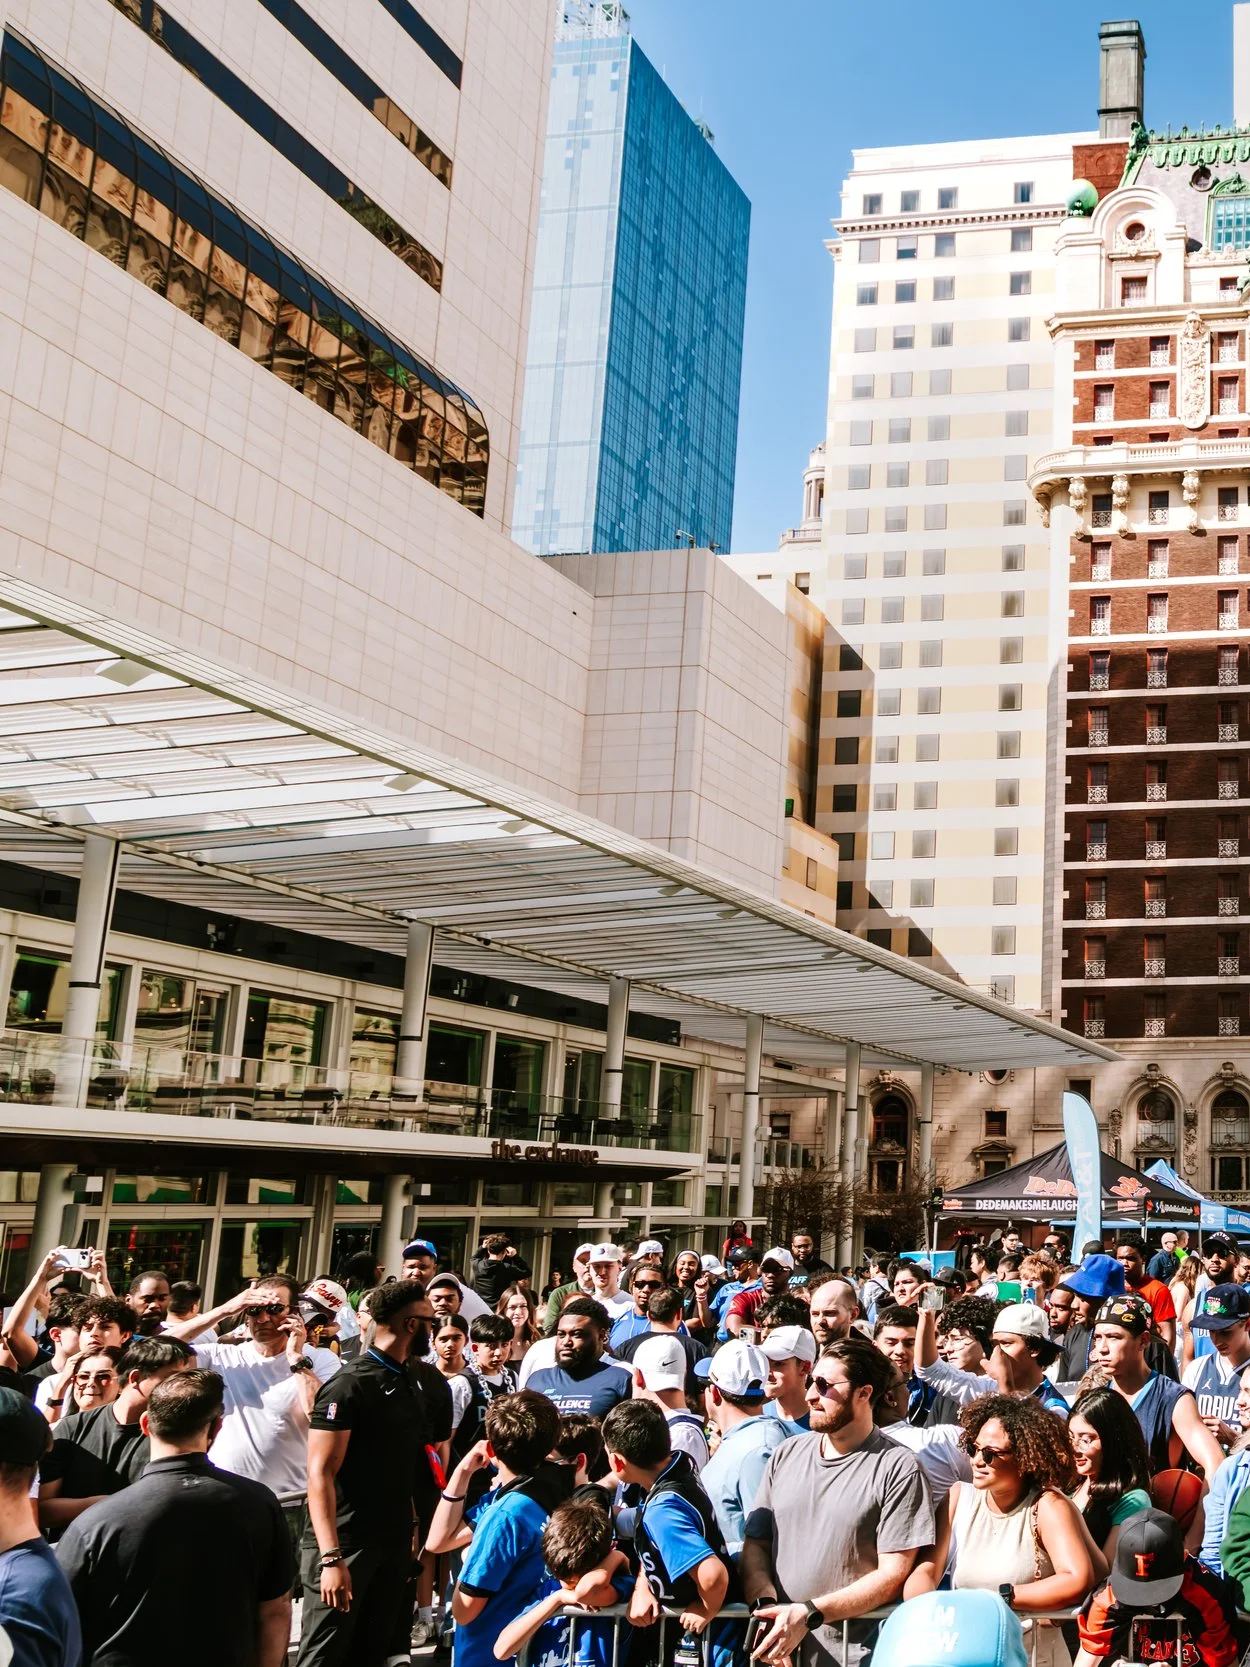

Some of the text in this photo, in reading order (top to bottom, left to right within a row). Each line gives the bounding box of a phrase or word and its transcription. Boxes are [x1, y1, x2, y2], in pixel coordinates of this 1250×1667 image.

[491, 1138, 599, 1166] the exchange
[976, 1200, 1104, 1212] DEDEMAKESMELAUGH
[1134, 1552, 1155, 1577] F
